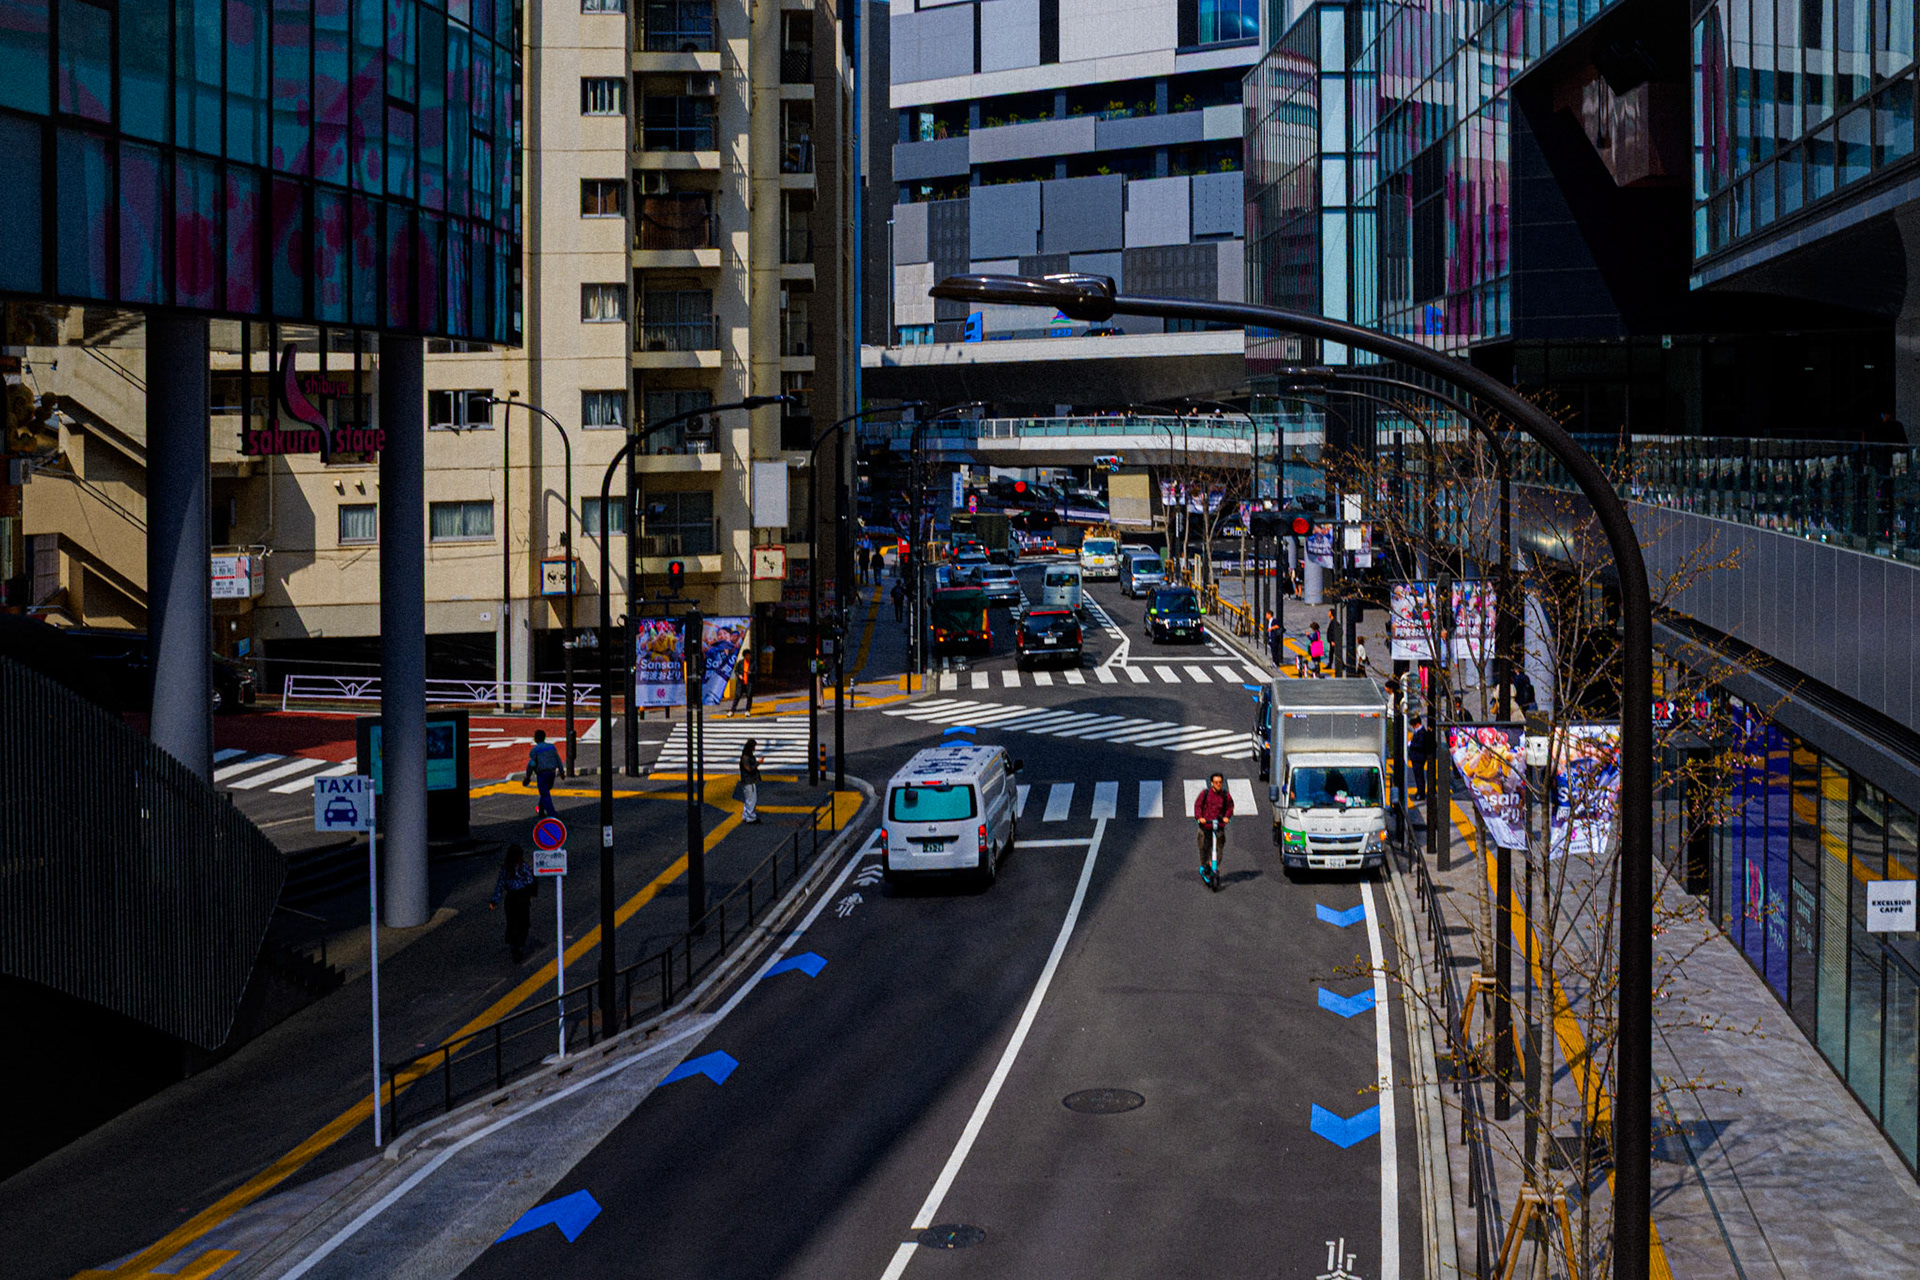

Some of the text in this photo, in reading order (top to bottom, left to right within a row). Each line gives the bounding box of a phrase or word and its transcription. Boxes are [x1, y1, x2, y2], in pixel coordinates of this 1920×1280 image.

[304, 374, 349, 398] shibuya
[249, 419, 386, 462] sakura stage
[640, 658, 681, 670] Sansan
[639, 670, 681, 681] 阿波おどり
[317, 778, 362, 794] TAXI
[1871, 899, 1912, 907] EXCELSIOR
